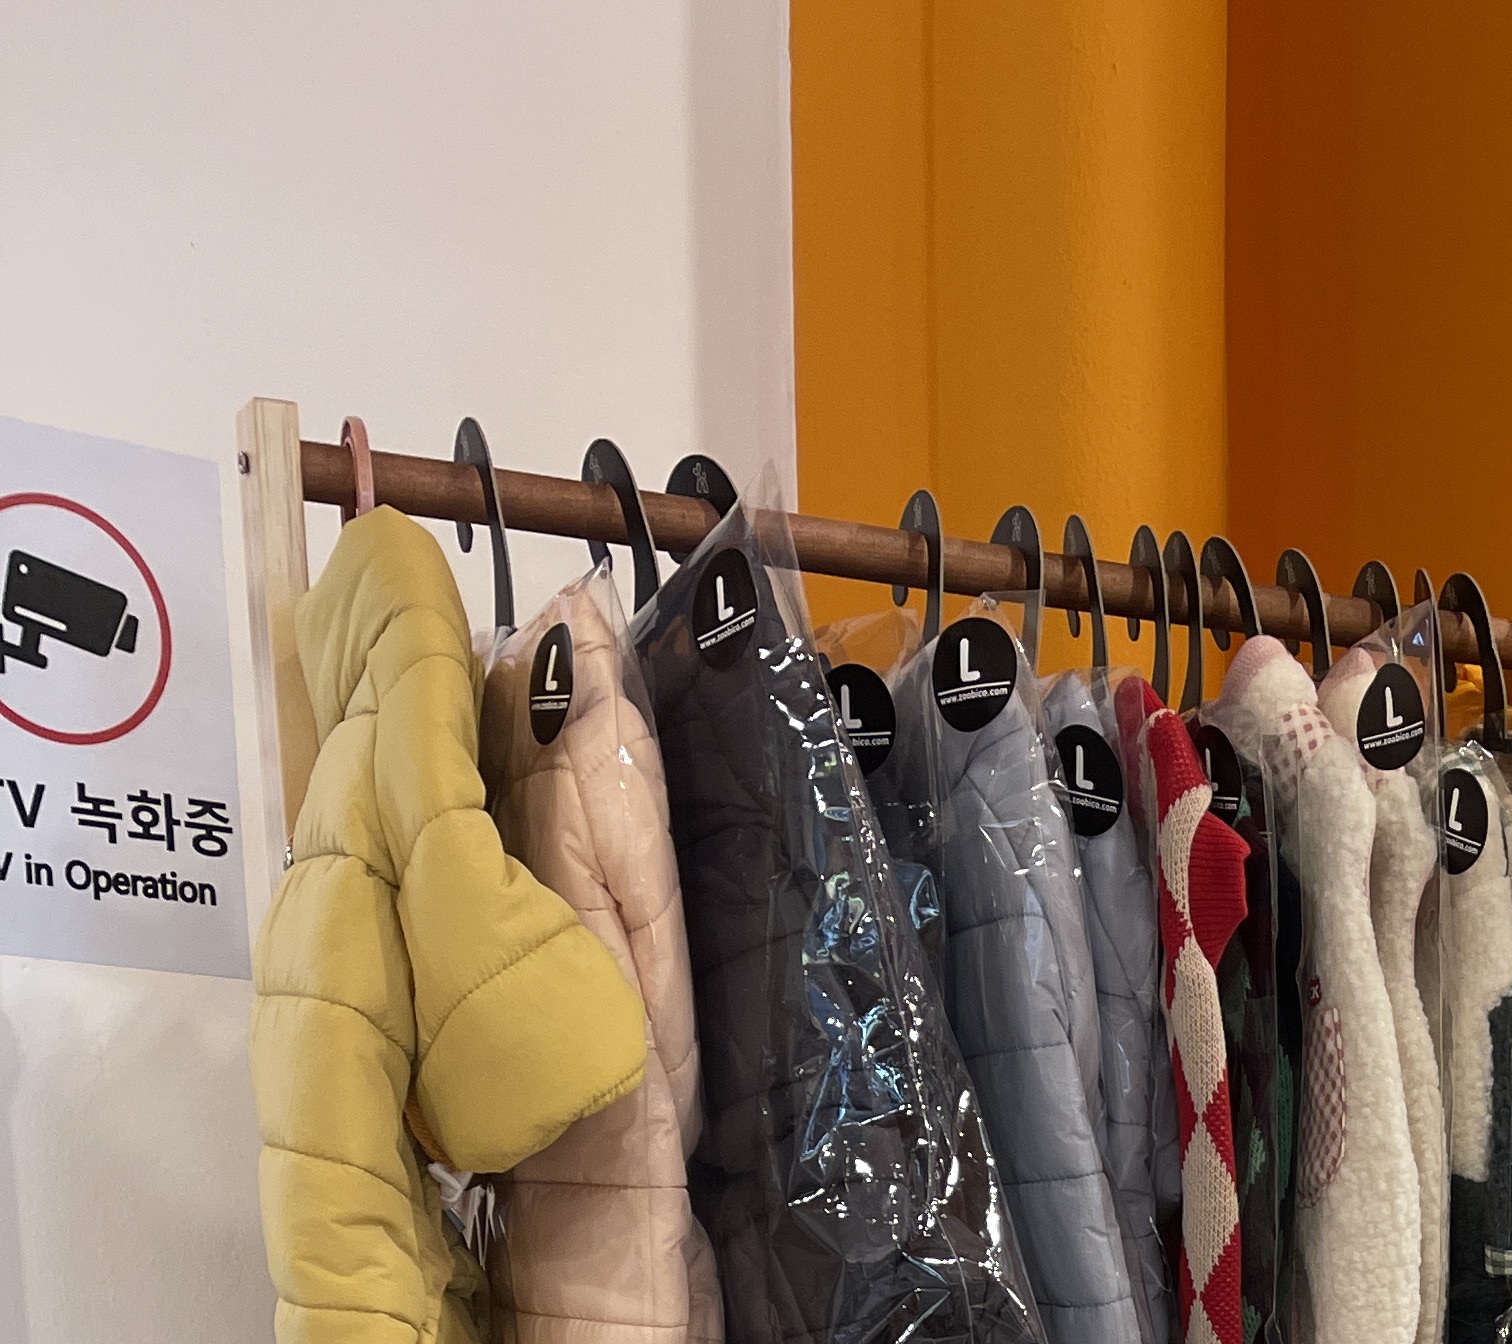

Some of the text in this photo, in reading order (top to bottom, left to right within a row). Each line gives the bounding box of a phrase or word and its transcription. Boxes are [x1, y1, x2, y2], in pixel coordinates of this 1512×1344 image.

[715, 575, 735, 622] L
[959, 638, 981, 683] L
[840, 684, 862, 729] L
[1384, 687, 1404, 728] L
[1075, 745, 1094, 791] L
[70, 782, 233, 858] 녹화중
[1446, 788, 1463, 832] L
[25, 854, 54, 888] in
[64, 859, 218, 906] Operation
